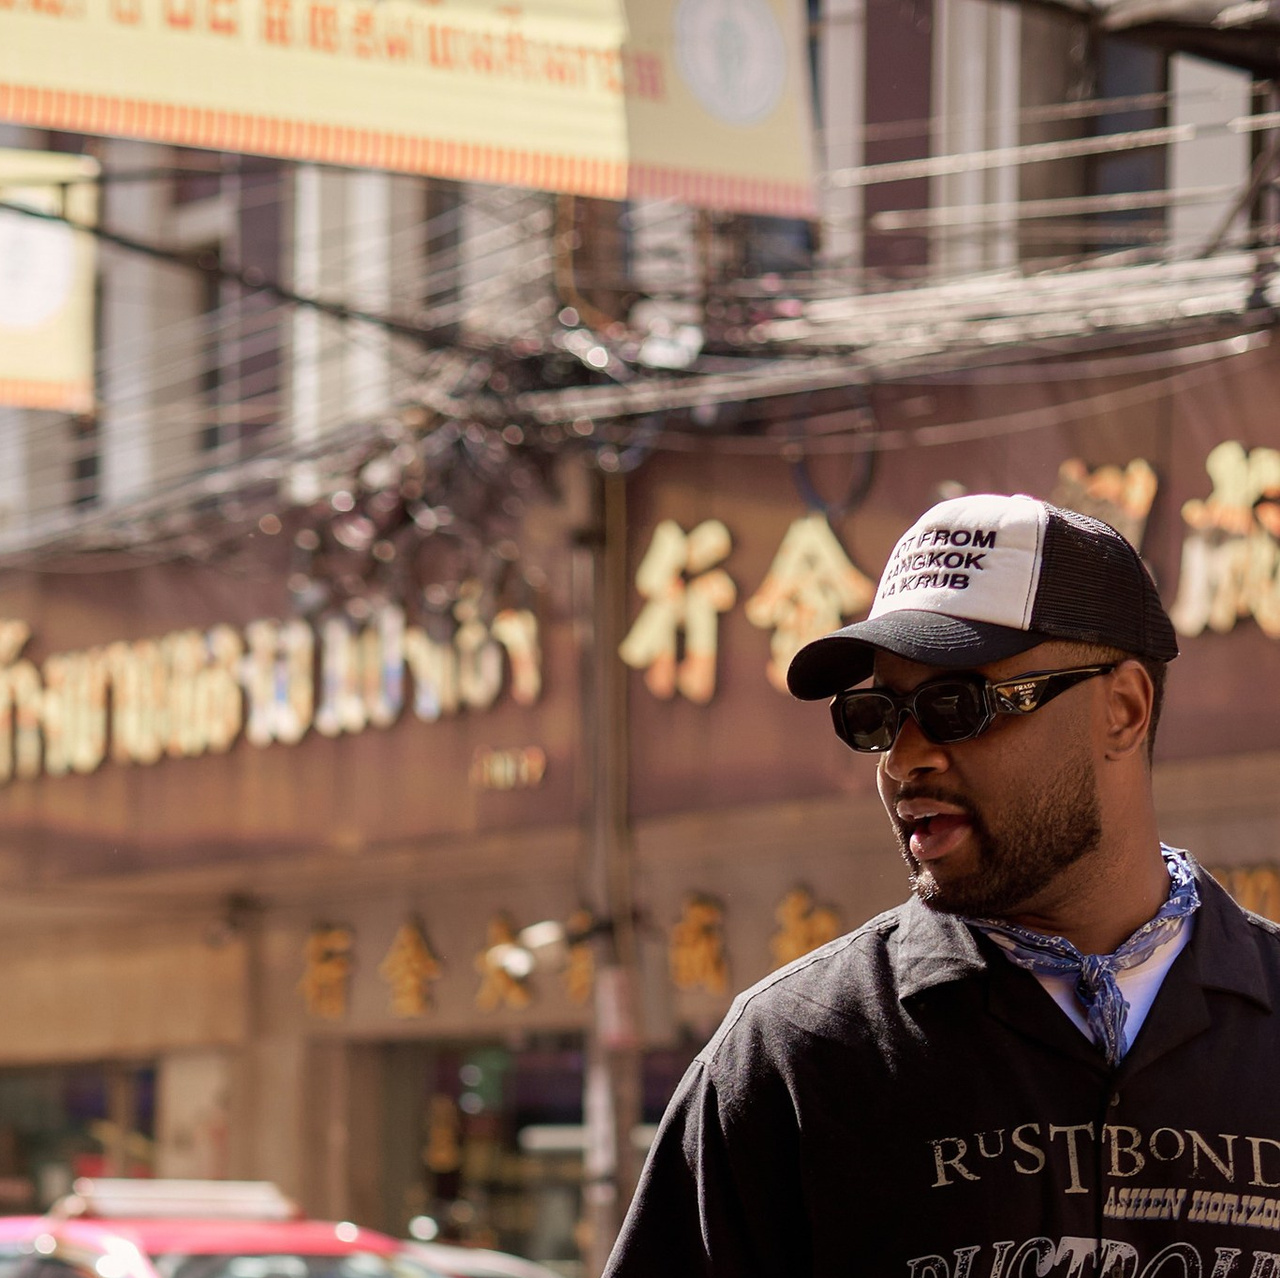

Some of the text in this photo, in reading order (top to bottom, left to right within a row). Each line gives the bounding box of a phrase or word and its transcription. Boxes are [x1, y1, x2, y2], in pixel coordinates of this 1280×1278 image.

[917, 529, 997, 549] FROM
[900, 573, 970, 593] KRUB
[1103, 1186, 1187, 1220] ASHEN
